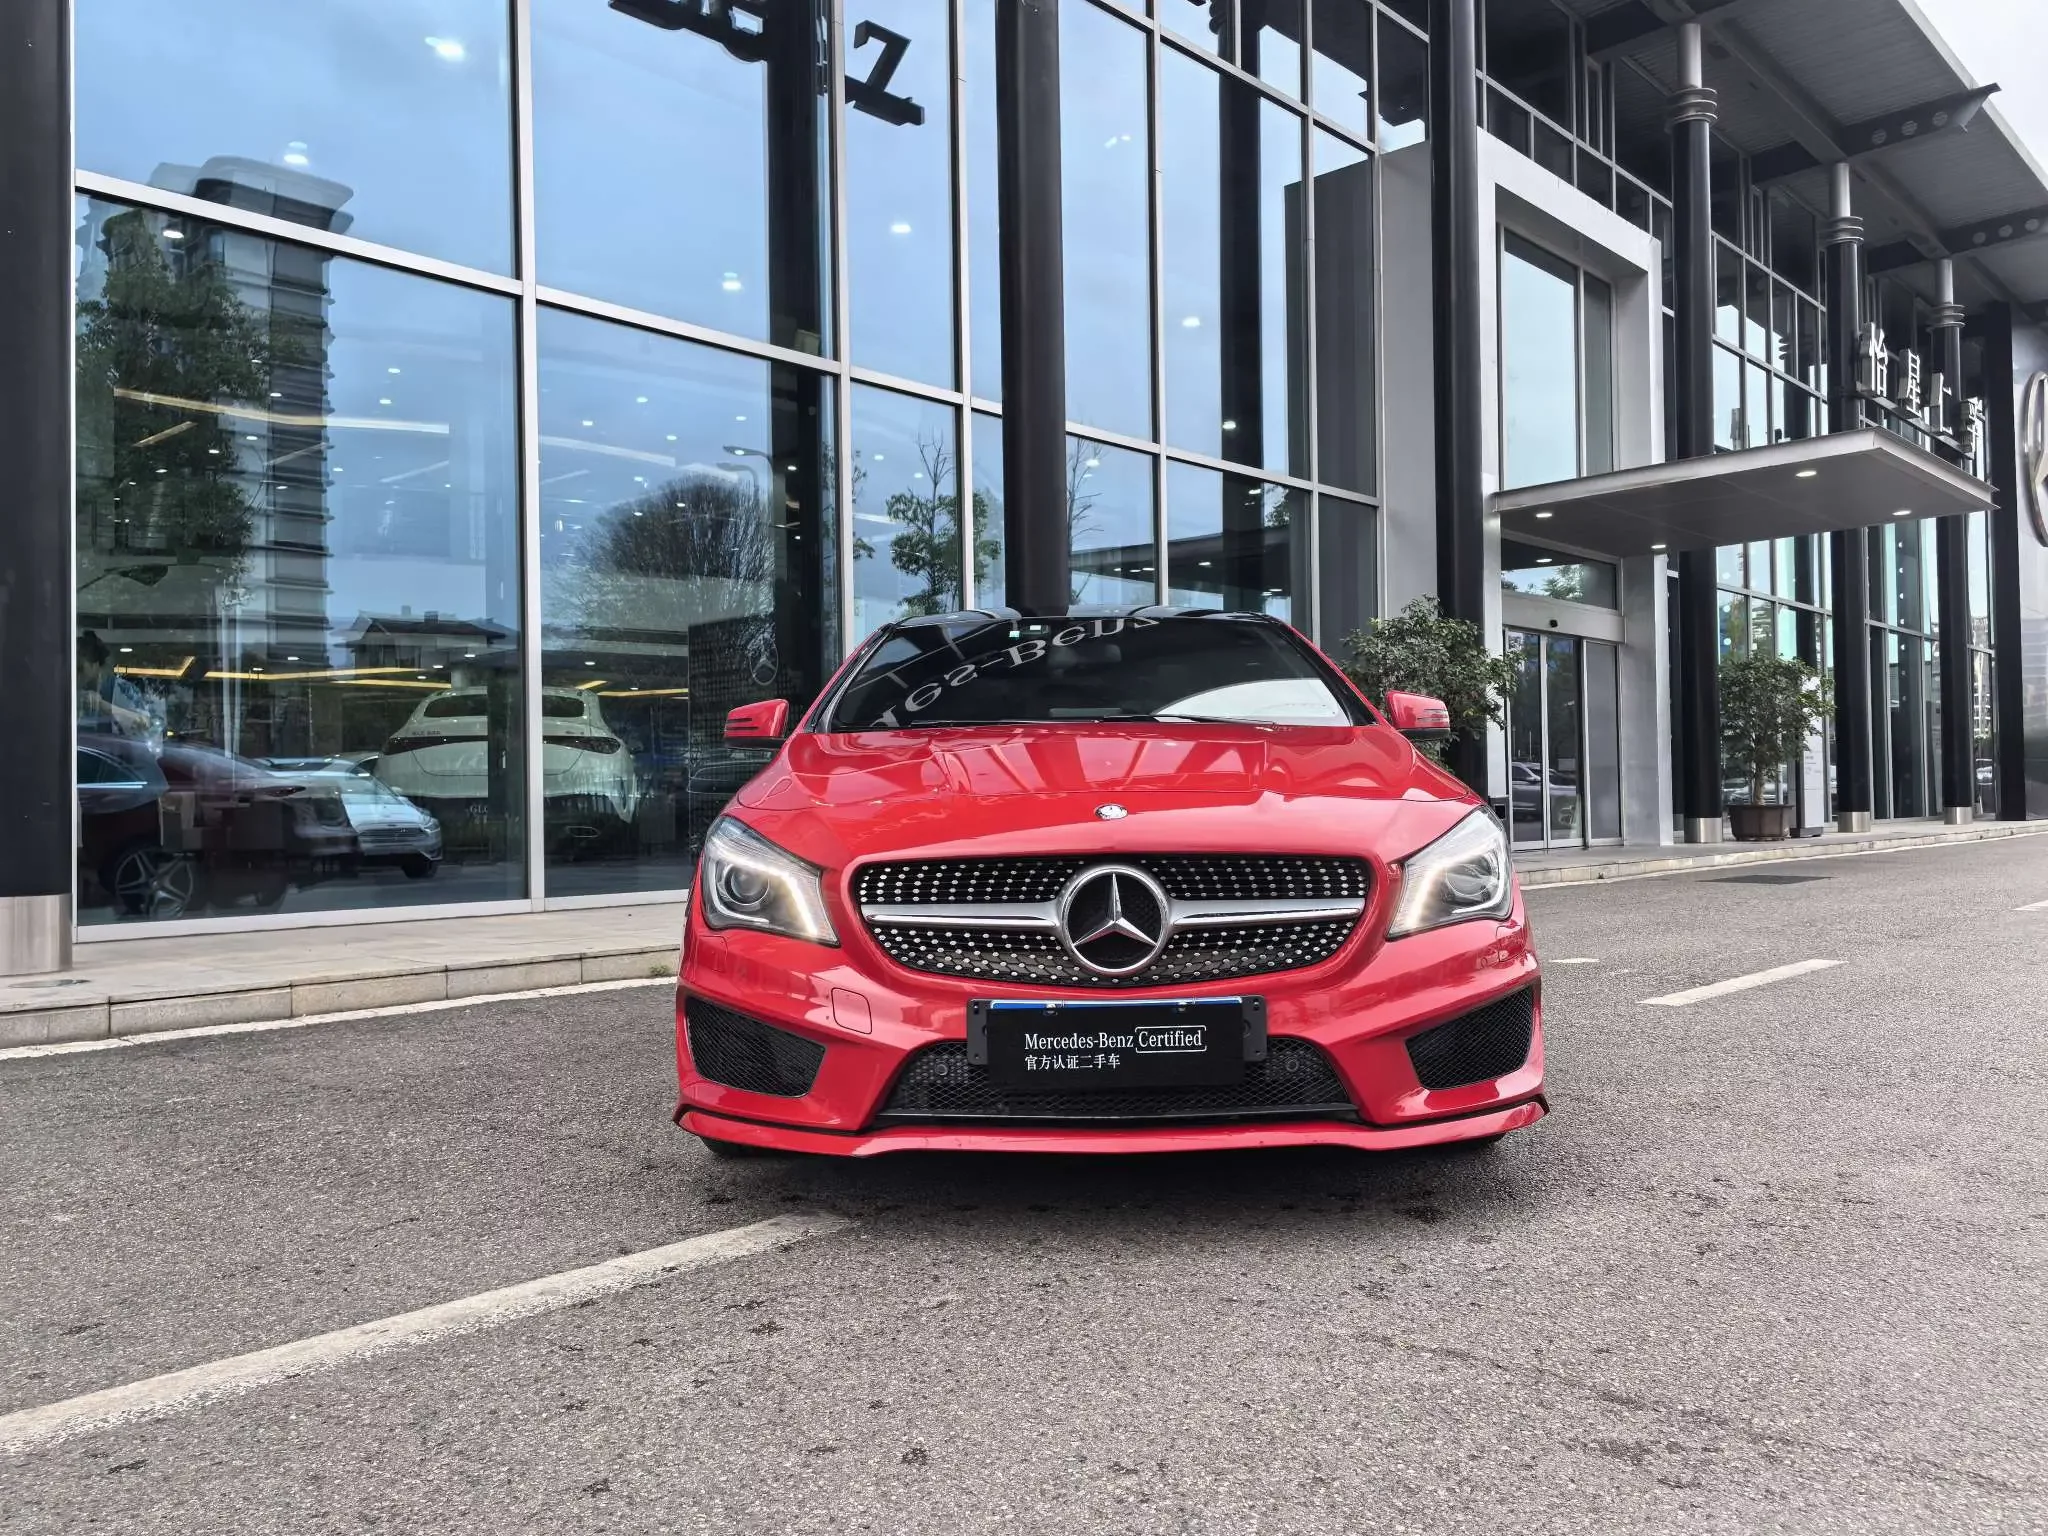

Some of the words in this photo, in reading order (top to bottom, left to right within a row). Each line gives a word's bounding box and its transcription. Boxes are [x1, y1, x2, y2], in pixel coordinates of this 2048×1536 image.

[1024, 1032, 1134, 1050] Mercedes-Benz
[1138, 1030, 1202, 1047] Certified
[1024, 1053, 1121, 1071] 官方认证二手车
